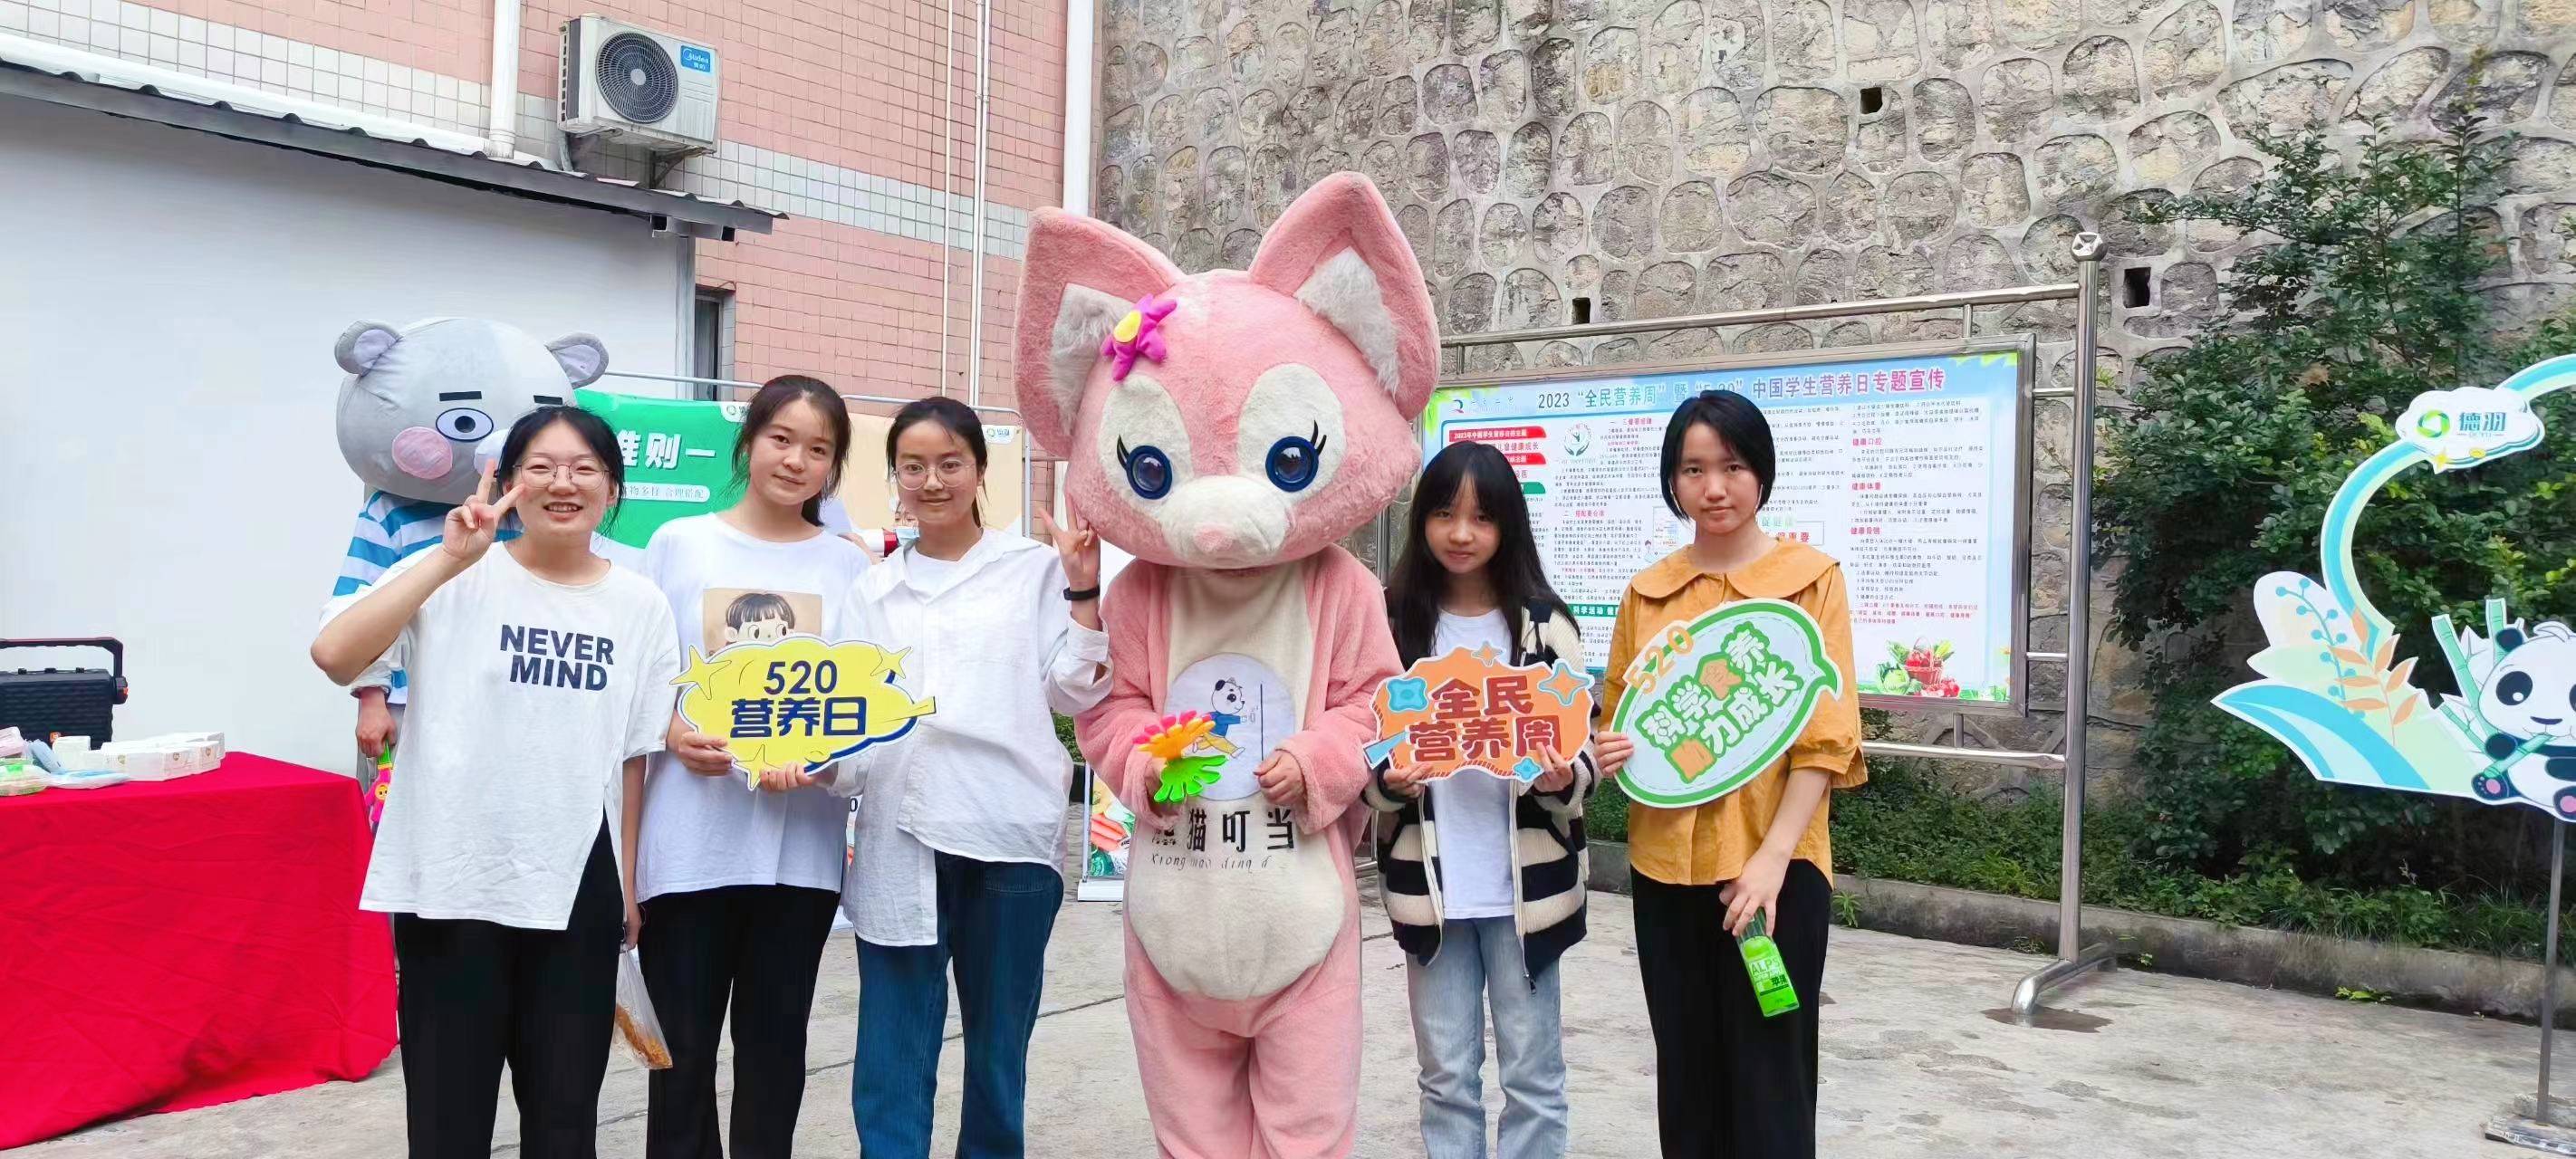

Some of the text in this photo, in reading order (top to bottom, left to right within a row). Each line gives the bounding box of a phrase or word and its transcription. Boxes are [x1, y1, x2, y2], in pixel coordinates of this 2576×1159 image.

[1539, 393, 1570, 407] 2023
[1754, 368, 1945, 398] 中国学生营养日专题宣传
[500, 625, 614, 665] NEVER
[1625, 626, 1695, 694] 520
[510, 655, 608, 691] MIND
[764, 659, 838, 694] 520
[730, 696, 867, 738] 营养日
[1430, 675, 1534, 720] 全民
[1409, 715, 1562, 762] 营养周
